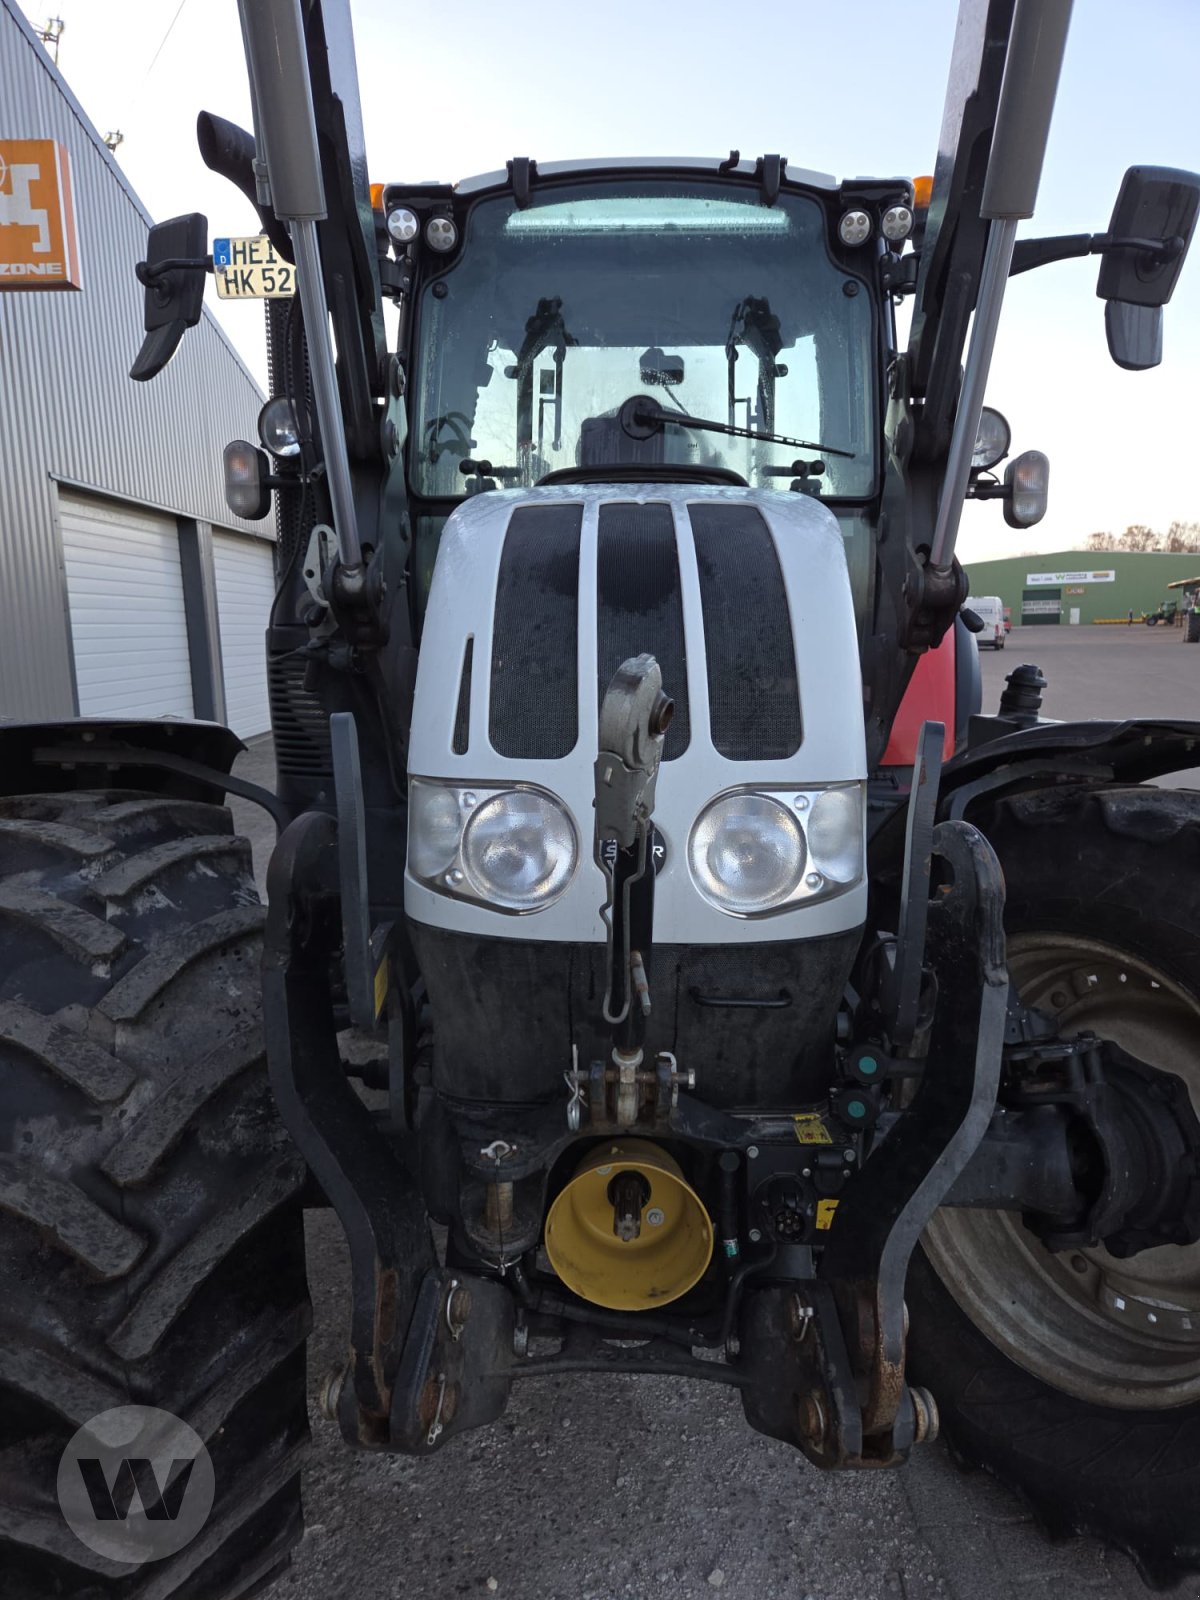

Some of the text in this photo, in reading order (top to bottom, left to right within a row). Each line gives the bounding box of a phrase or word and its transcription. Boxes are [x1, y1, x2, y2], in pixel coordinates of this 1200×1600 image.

[220, 255, 226, 264] D
[232, 239, 277, 266] HEI
[224, 267, 297, 295] HK 52
